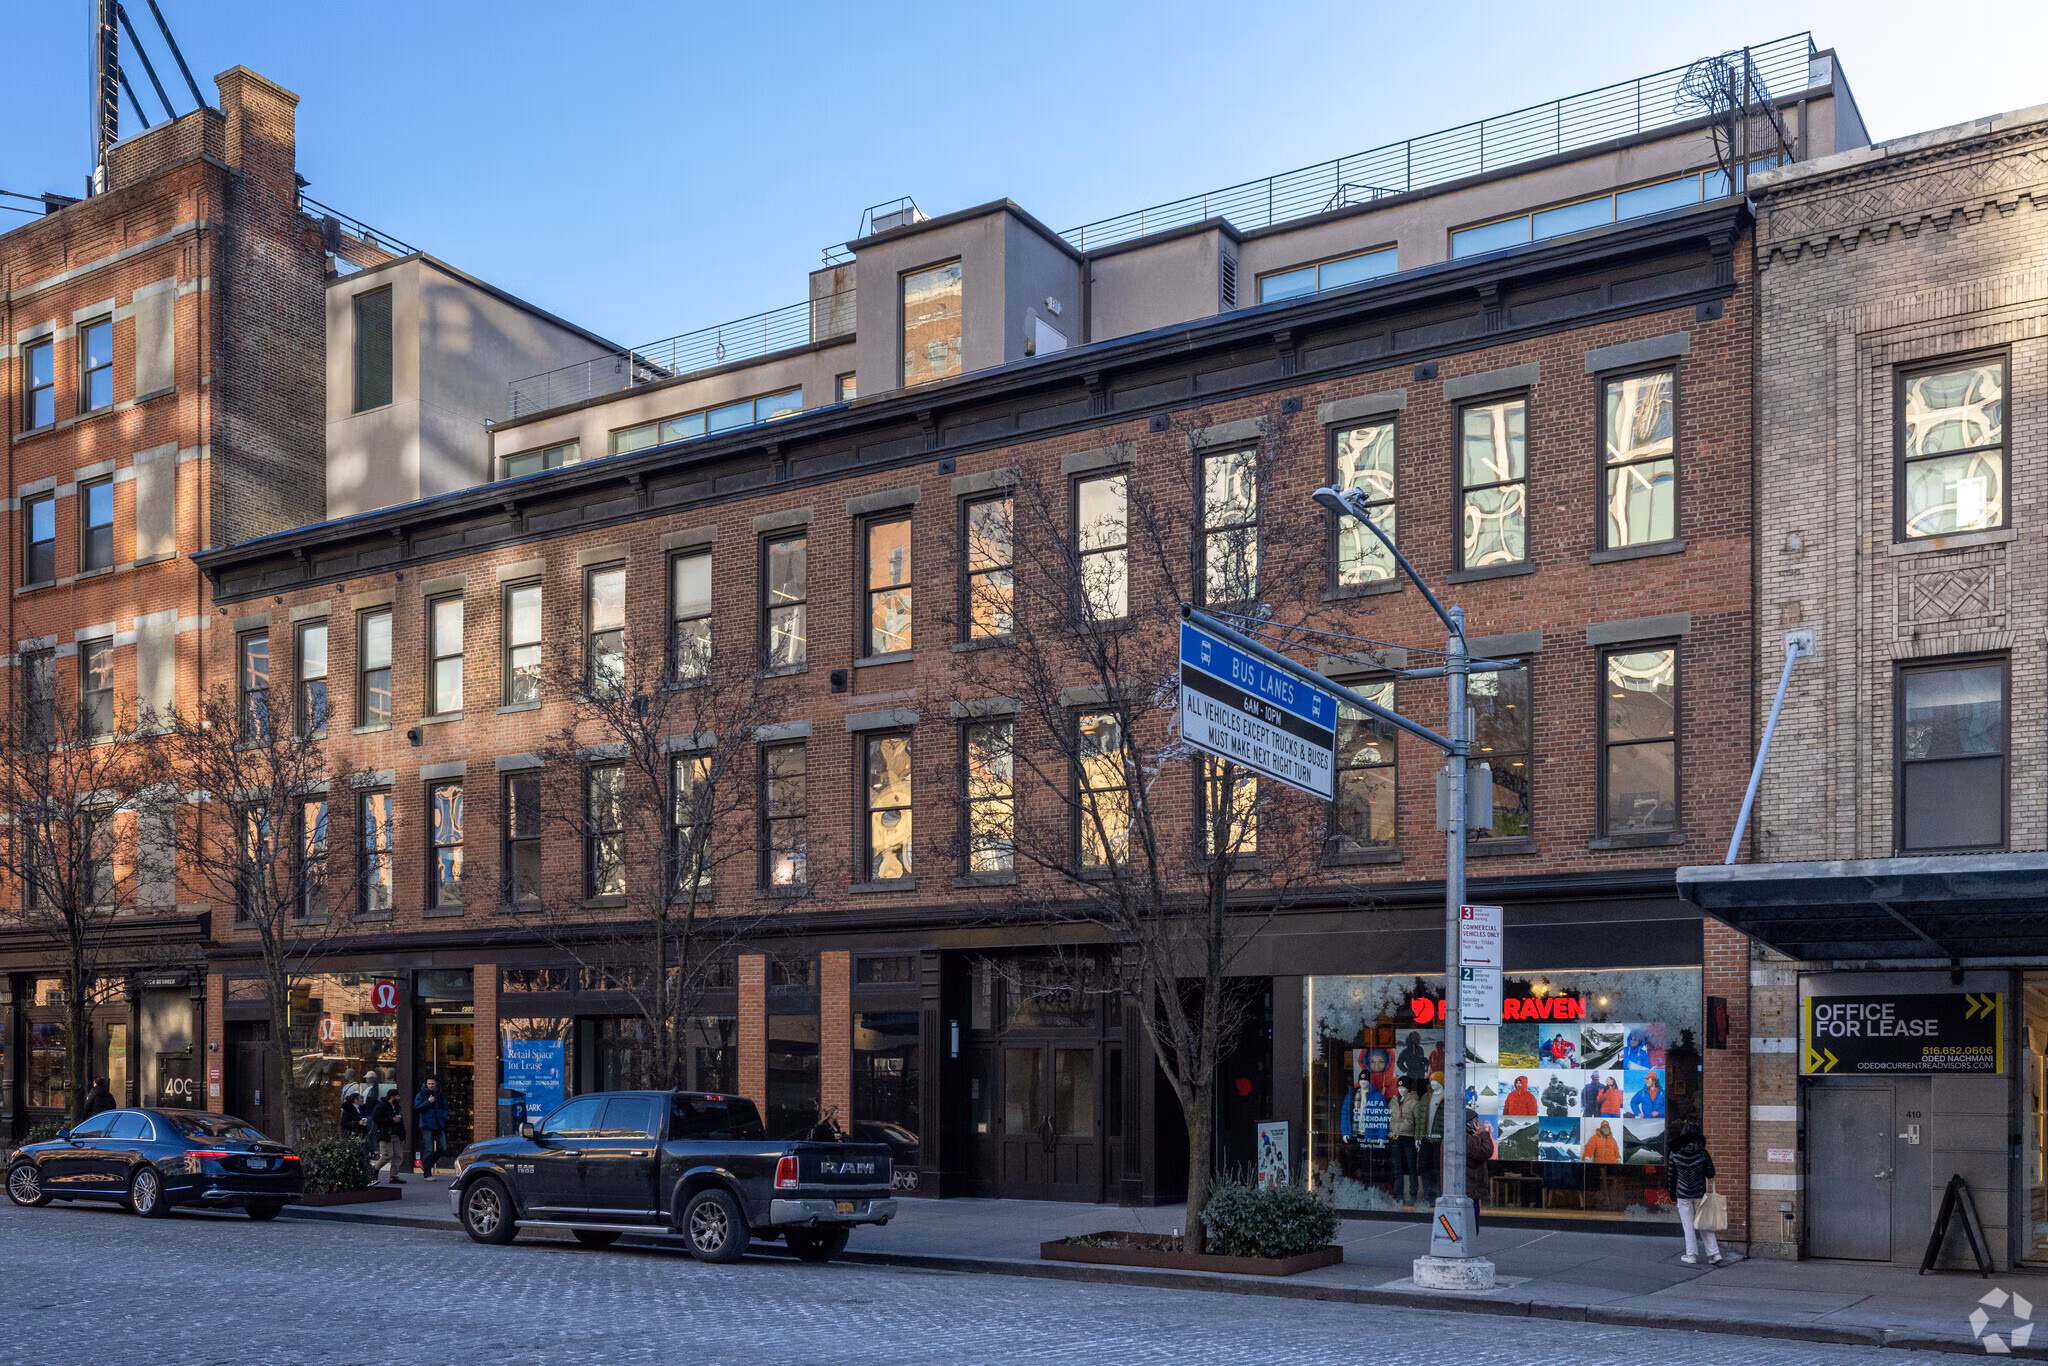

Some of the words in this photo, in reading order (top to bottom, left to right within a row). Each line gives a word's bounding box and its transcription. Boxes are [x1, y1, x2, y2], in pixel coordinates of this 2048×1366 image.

[1232, 657, 1254, 686] BUS
[1260, 671, 1294, 704] LANES
[1244, 697, 1260, 716] 6AM
[1265, 706, 1282, 726] 10PM
[1187, 694, 1202, 716] ALL
[1204, 701, 1240, 733] VEHICLES
[1244, 718, 1270, 746] EXCEPT
[1272, 731, 1298, 758] TRUCKS
[1300, 744, 1306, 761] &
[1308, 747, 1329, 770] BUSES
[1208, 726, 1228, 748] MUST
[1231, 736, 1251, 759] MAKE
[1253, 746, 1270, 767] NEXT
[1273, 754, 1292, 776] RIGHT
[1294, 762, 1311, 784] TURN
[1464, 908, 1471, 918] 3
[1464, 969, 1470, 980] 2
[1438, 998, 1586, 1020] FRÄVEN
[1815, 1003, 1895, 1021] OFFICE
[1816, 1021, 1860, 1037] FOR
[1867, 1019, 1938, 1036] LEASE
[508, 1049, 531, 1059] Retail
[532, 1049, 555, 1062] Space
[508, 1060, 519, 1070] for
[522, 1060, 542, 1070] Lease
[821, 1162, 874, 1174] RAM
